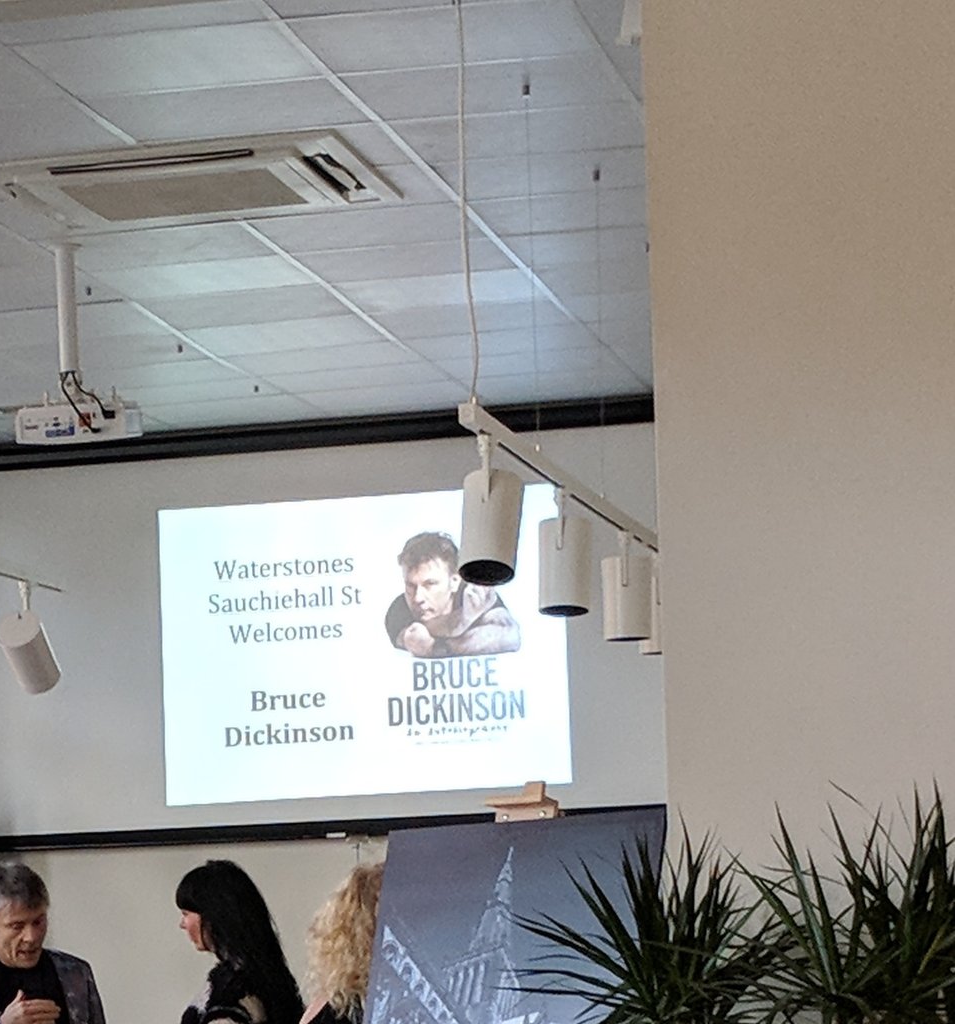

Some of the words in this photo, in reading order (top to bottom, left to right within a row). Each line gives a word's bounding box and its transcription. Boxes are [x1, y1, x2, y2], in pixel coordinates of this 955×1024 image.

[214, 556, 354, 582] Waterstones
[208, 588, 334, 614] Sauchiehall
[341, 586, 362, 606] St
[230, 621, 343, 644] Welcomes
[413, 657, 498, 691] BRUCE
[250, 690, 326, 712] Bruce
[388, 689, 525, 726] DICKINSON
[224, 723, 354, 747] Dickinson
